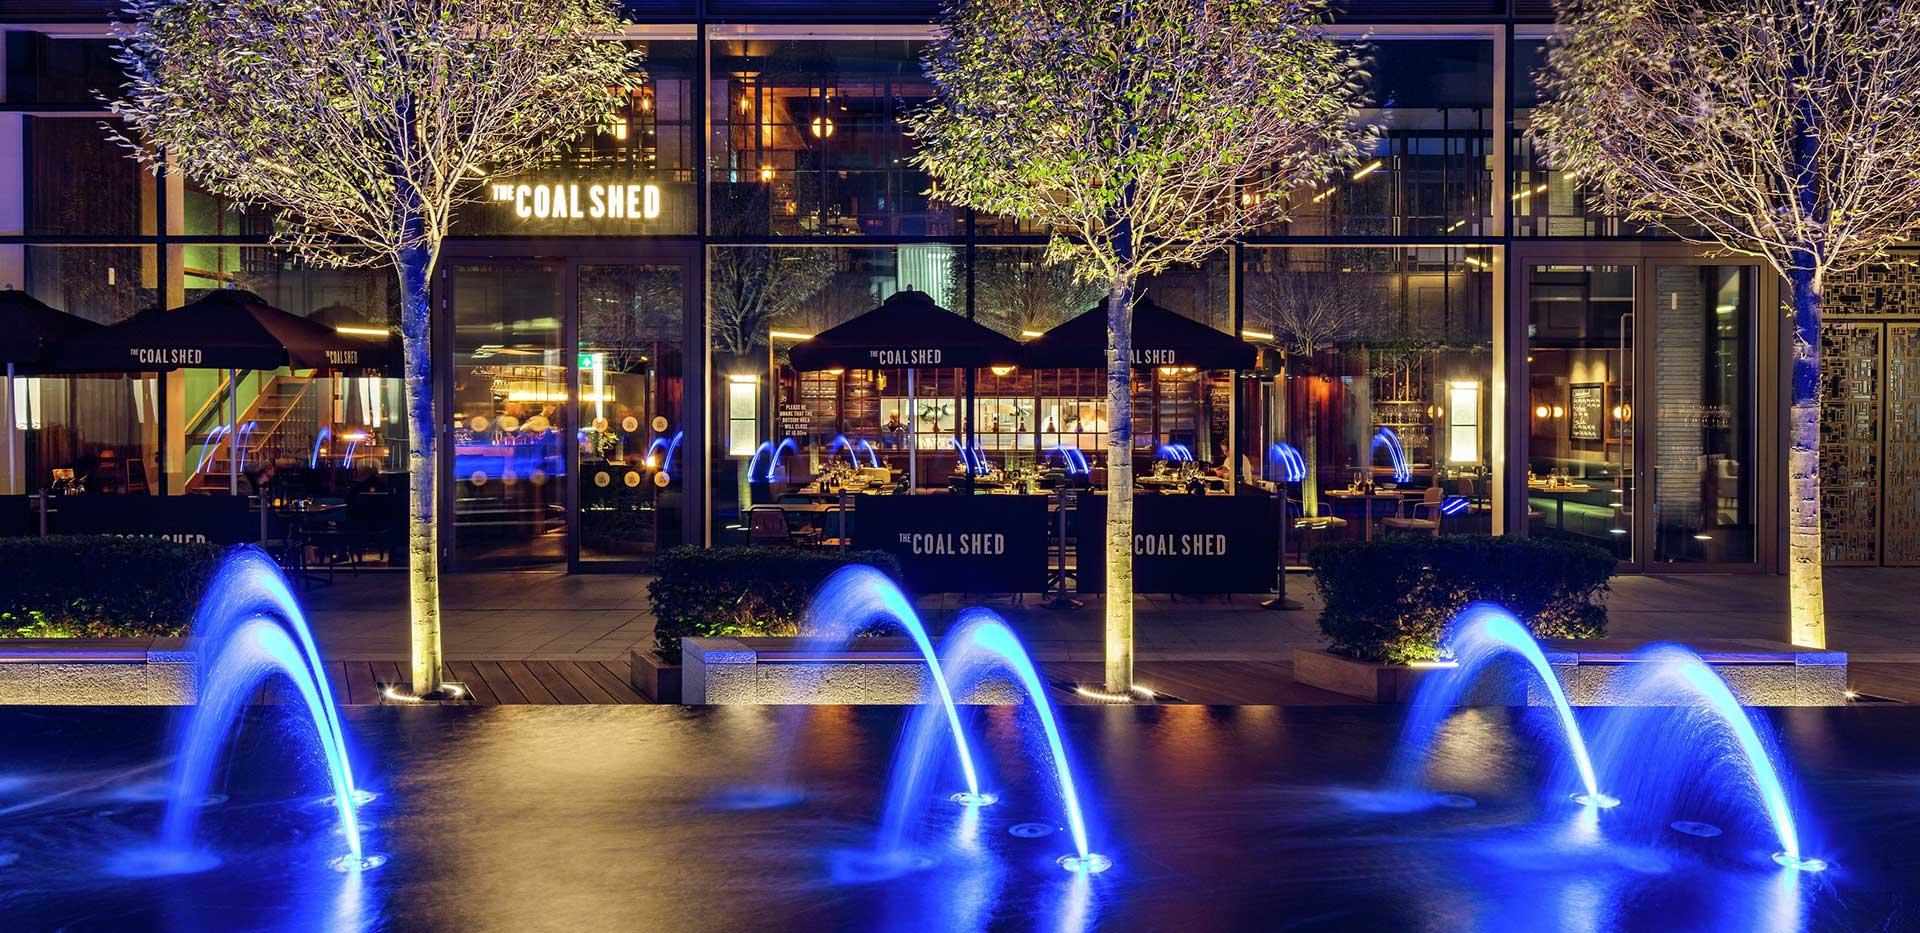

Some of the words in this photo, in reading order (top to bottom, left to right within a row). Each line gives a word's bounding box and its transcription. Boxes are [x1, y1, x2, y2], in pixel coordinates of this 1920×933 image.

[492, 184, 515, 201] THE
[515, 184, 585, 219] COAL
[589, 184, 661, 219] SHED
[130, 348, 139, 356] THE
[139, 348, 169, 364] COAL
[171, 348, 202, 364] SHED
[330, 350, 344, 364] COAL
[344, 350, 358, 365] SHED
[870, 350, 879, 358] THE
[880, 349, 909, 365] COAL
[911, 349, 942, 365] SHED
[1144, 349, 1176, 364] SHED
[899, 533, 911, 543] THE
[912, 533, 956, 555] COAL
[959, 533, 1005, 555] SHED
[1134, 534, 1177, 556] COAL
[1181, 534, 1227, 556] SHED
